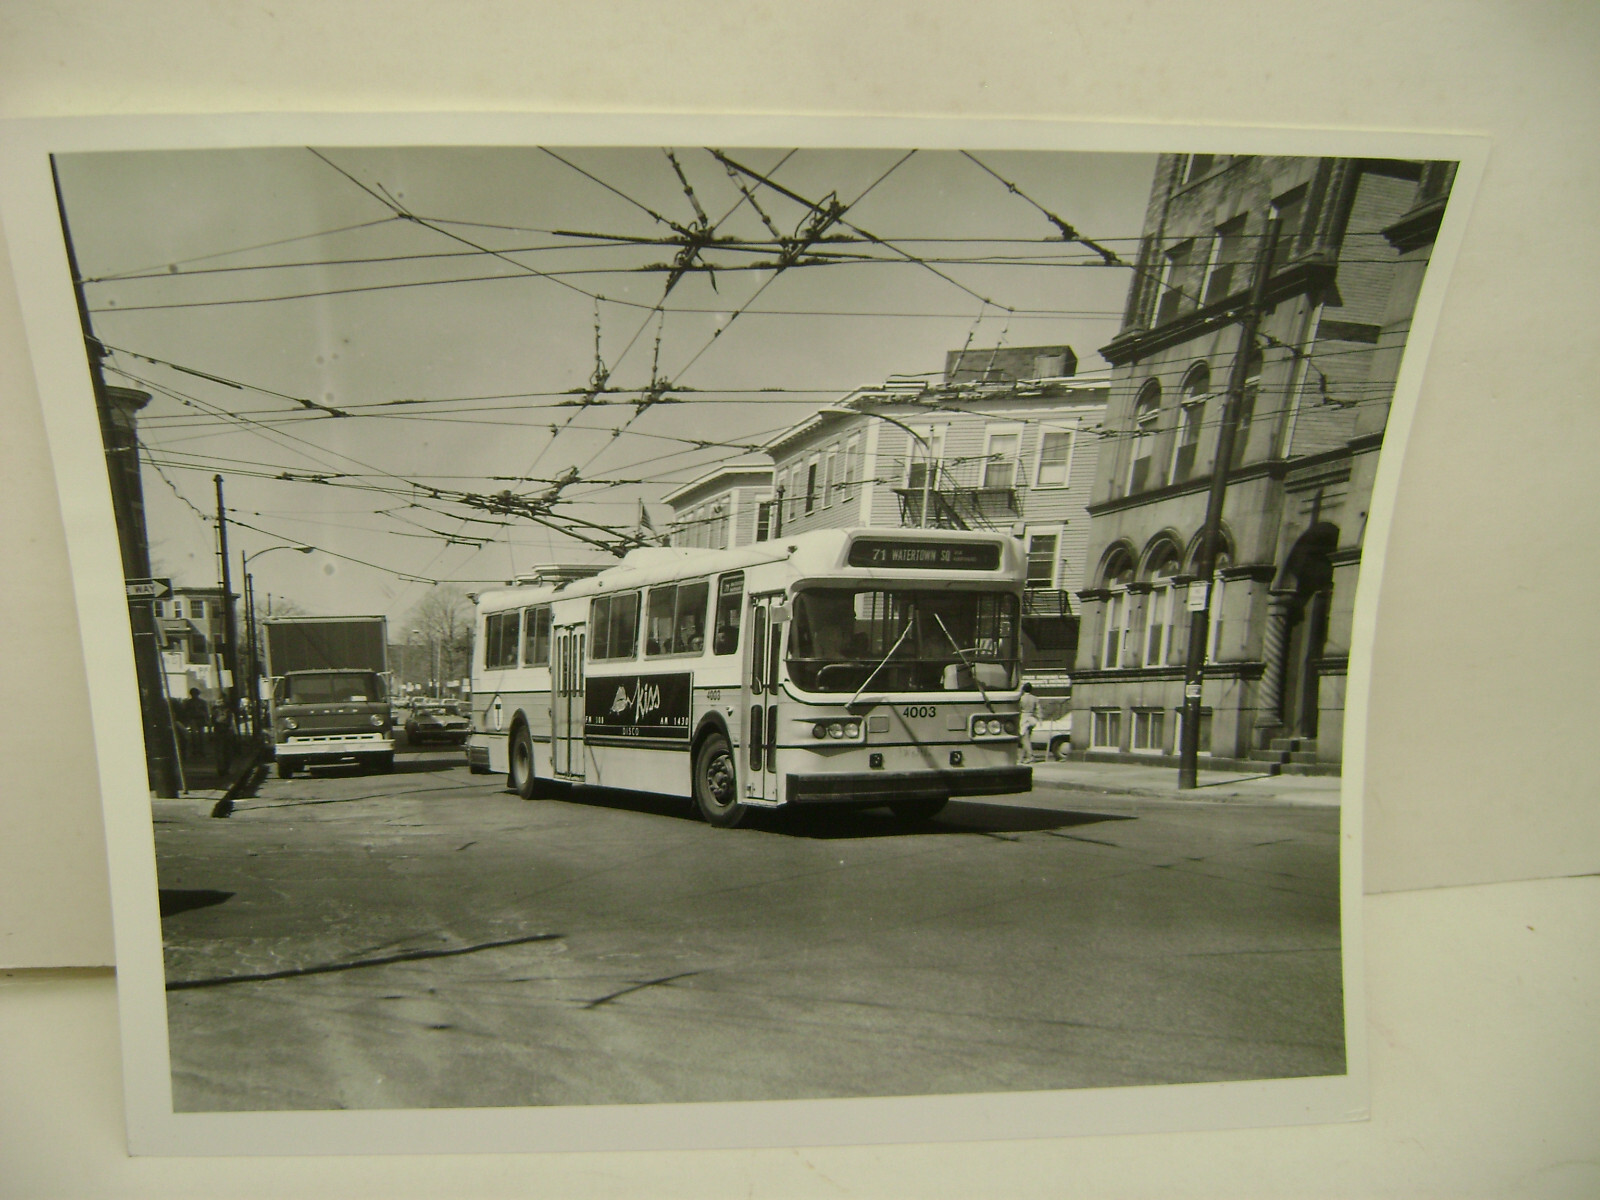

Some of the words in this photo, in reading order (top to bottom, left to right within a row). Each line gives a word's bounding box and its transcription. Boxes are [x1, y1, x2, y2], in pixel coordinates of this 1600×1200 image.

[872, 549, 886, 561] 71
[892, 549, 936, 561] WATERTOWN
[940, 549, 951, 562] SQ
[707, 689, 721, 701] 4003
[902, 706, 936, 718] 4003
[674, 717, 689, 725] 1430
[623, 727, 639, 736] DISCO
